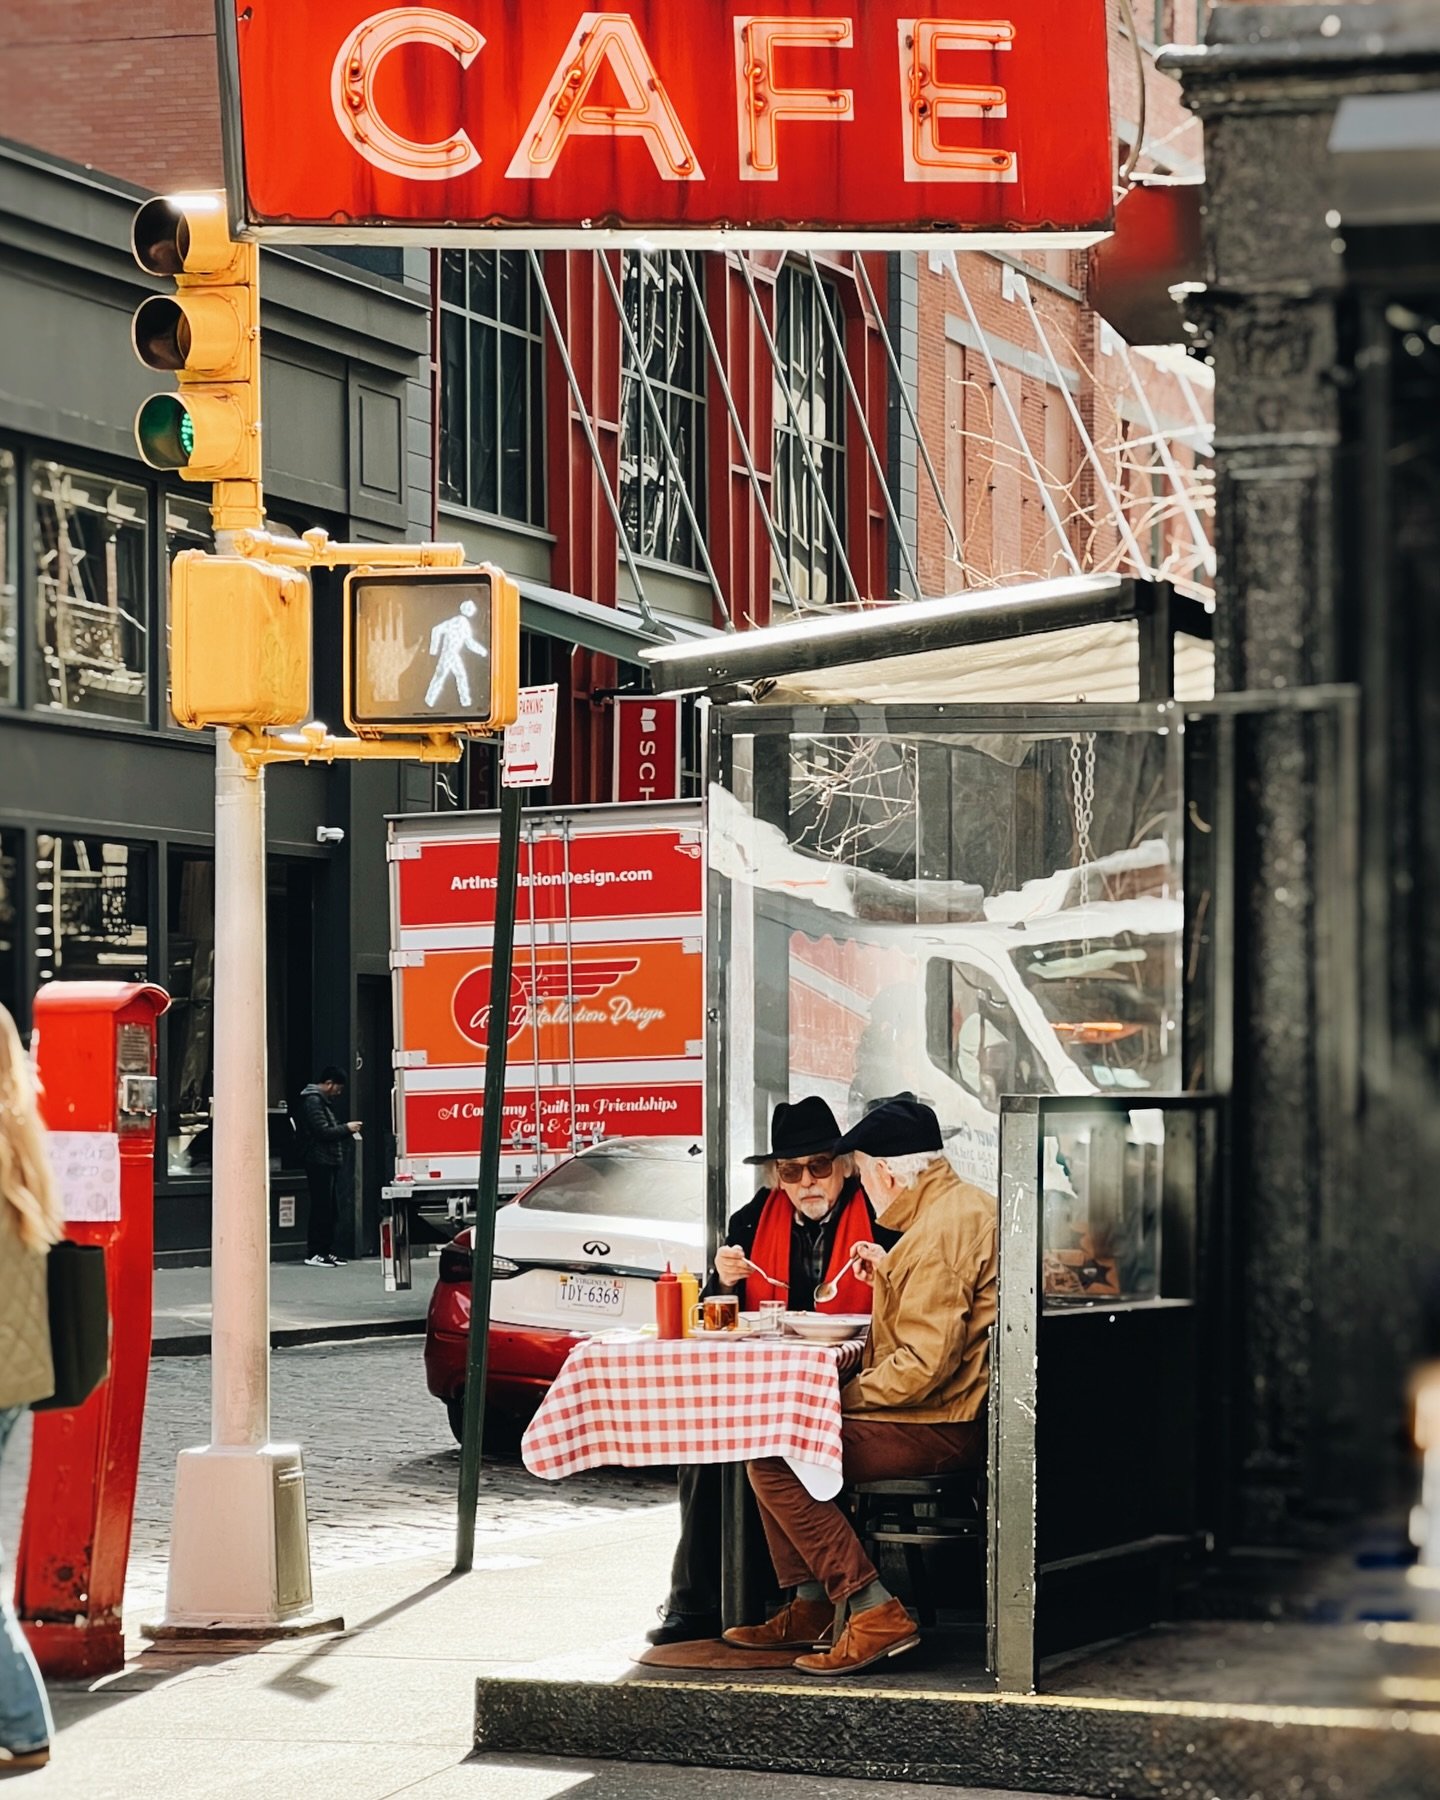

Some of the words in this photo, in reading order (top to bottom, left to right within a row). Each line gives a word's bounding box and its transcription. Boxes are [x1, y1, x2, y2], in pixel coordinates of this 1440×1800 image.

[330, 7, 1018, 183] CAFE
[451, 869, 653, 891] ArtInslationDesign.com
[608, 996, 666, 1031] Design
[438, 1103, 459, 1120] A
[461, 1102, 527, 1119] Coany
[530, 1099, 570, 1116] Built
[593, 1097, 678, 1115] Friendships
[509, 1118, 544, 1135] Tom
[547, 1118, 560, 1133] &
